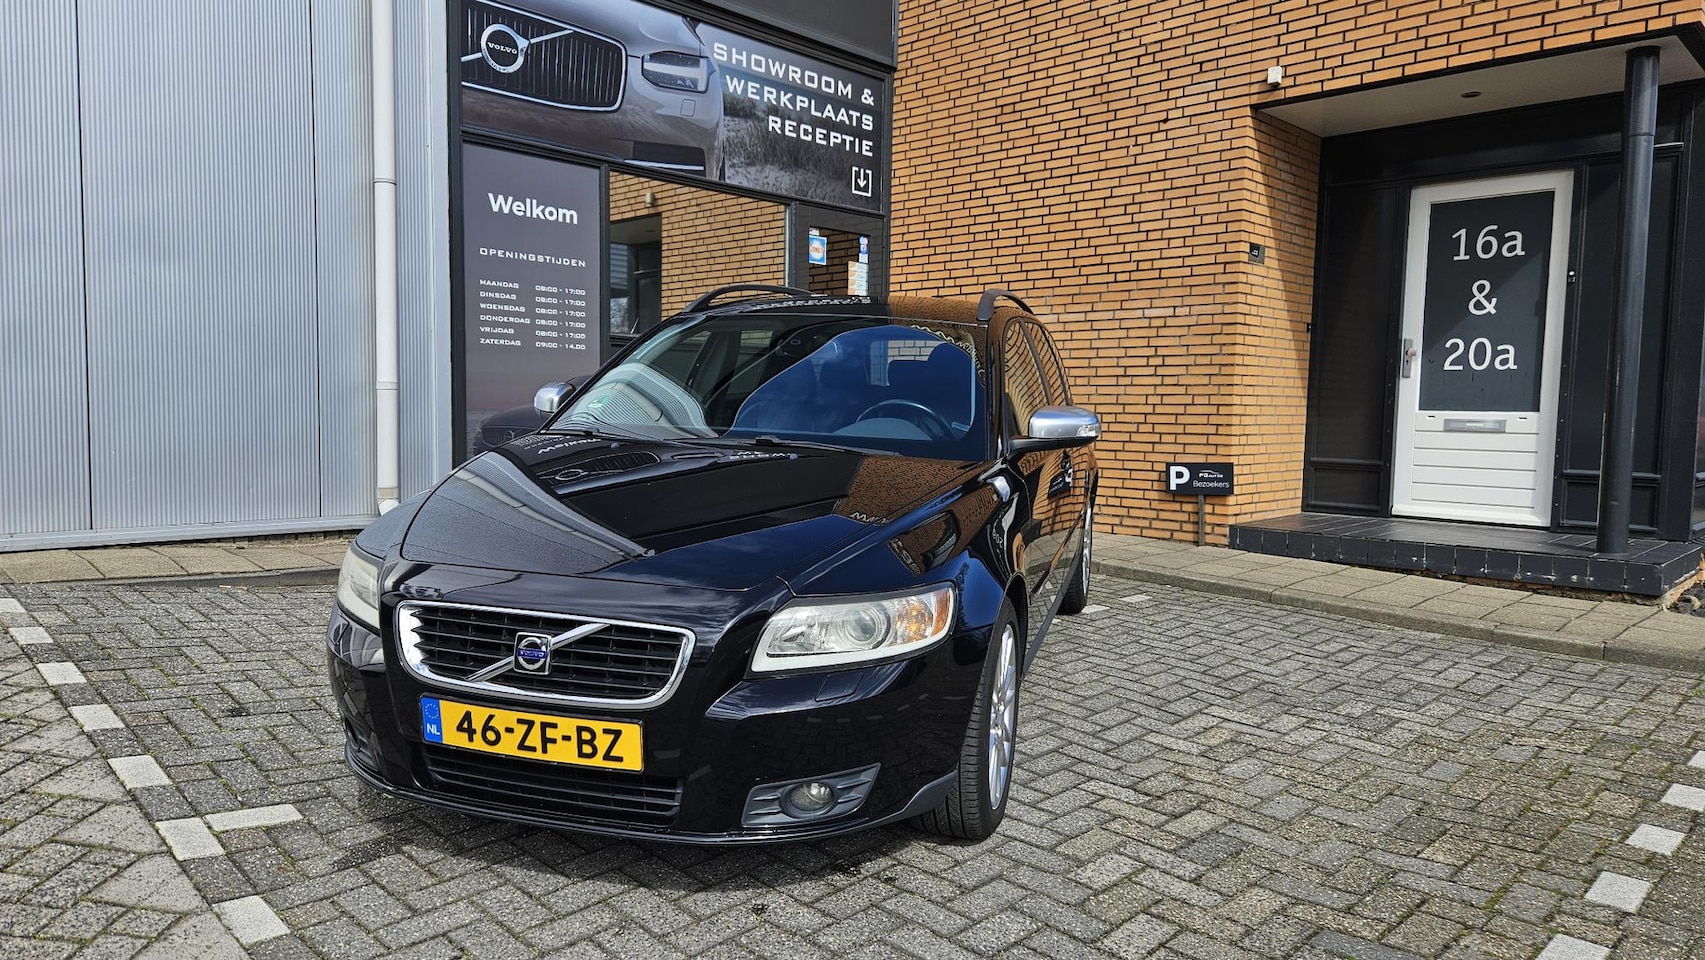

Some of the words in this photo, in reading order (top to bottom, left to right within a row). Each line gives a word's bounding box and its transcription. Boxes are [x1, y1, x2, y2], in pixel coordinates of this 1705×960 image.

[487, 41, 518, 55] VOLVO
[713, 42, 852, 99] SHOWROOM
[861, 89, 875, 106] &
[725, 75, 874, 131] WERKPLAATS
[768, 115, 874, 157] RECEPTIE
[487, 192, 578, 225] Welkom
[1451, 224, 1526, 261] 16a
[479, 247, 586, 268] OPENINGSTIJDEN
[479, 279, 520, 289] MAANDAG
[479, 291, 517, 301] DINSDAG
[1468, 279, 1498, 316] &
[479, 303, 526, 313] WOENSDAG
[479, 315, 531, 325] DONDERDAG
[479, 326, 515, 335] VRIJDAG
[479, 338, 522, 347] ZATERDAG
[1443, 337, 1518, 372] 20a
[1170, 466, 1190, 490] P
[1193, 480, 1230, 488] Bezoekers
[426, 723, 440, 735] NL
[456, 710, 624, 763] 46-ZF-BZ
